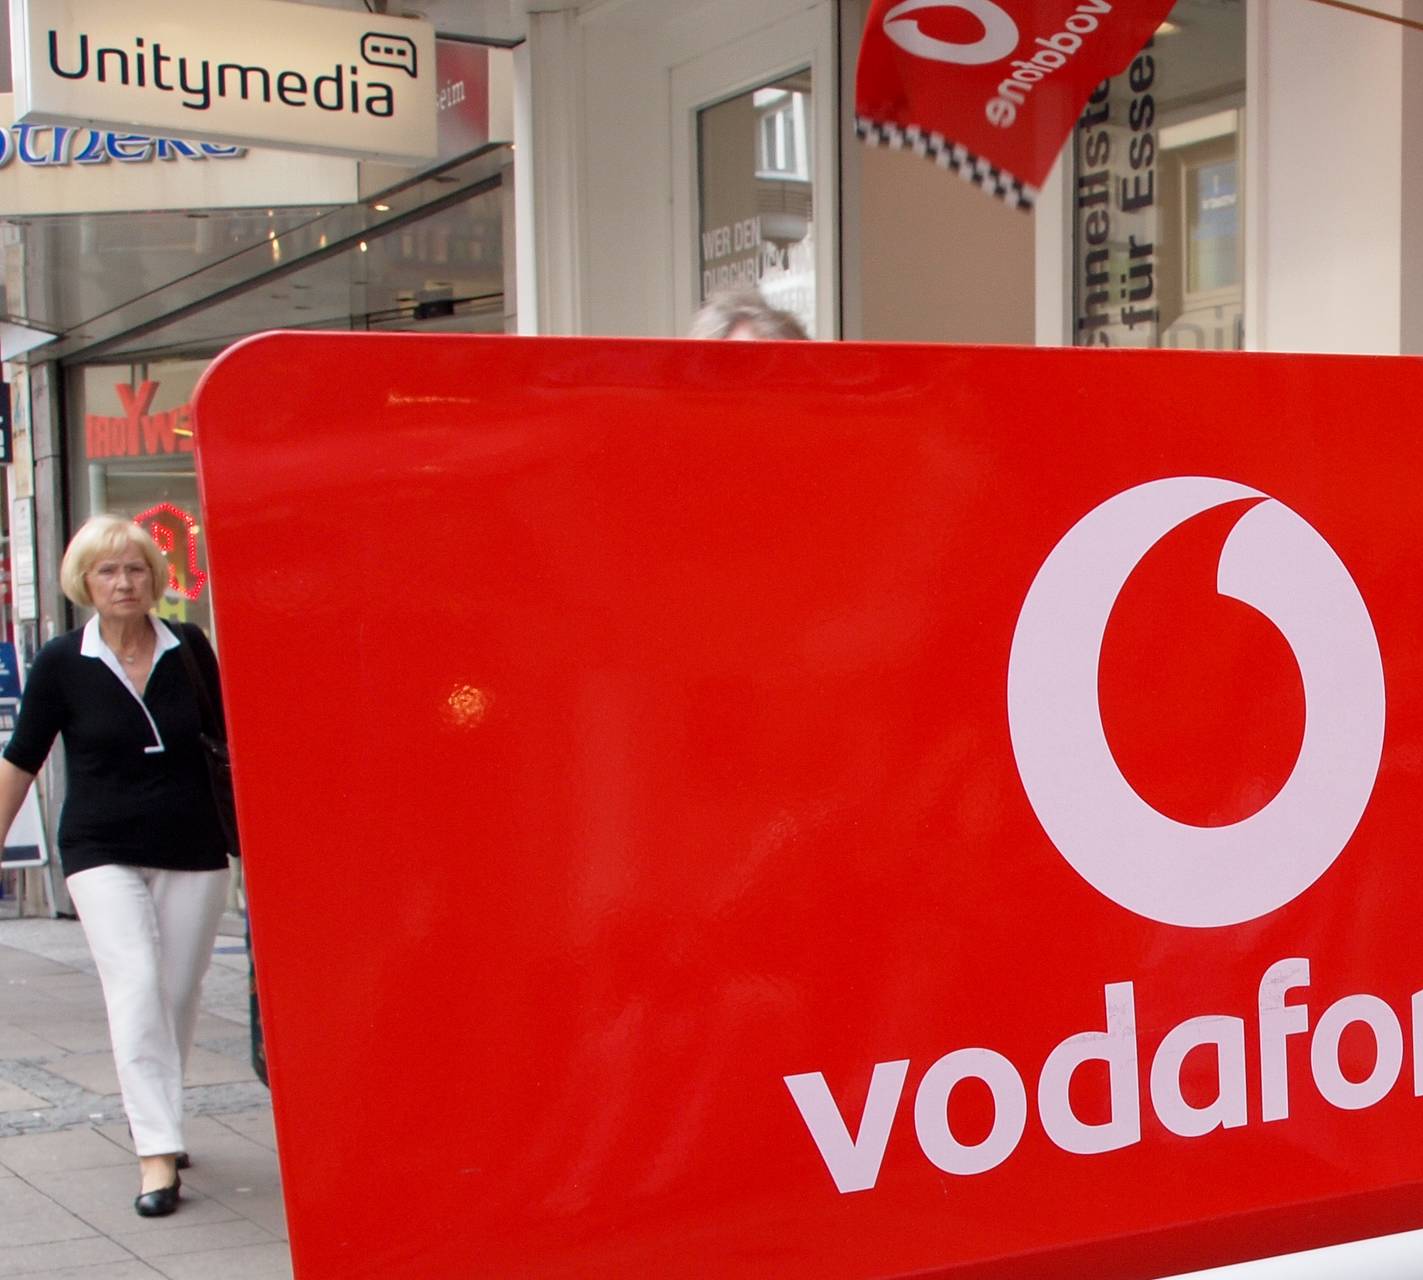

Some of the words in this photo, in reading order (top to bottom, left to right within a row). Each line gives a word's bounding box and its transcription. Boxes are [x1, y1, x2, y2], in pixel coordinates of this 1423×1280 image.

[48, 29, 395, 118] Unitymedia
[434, 78, 465, 113] eim
[1121, 36, 1155, 212] Esse
[1121, 236, 1155, 330] für
